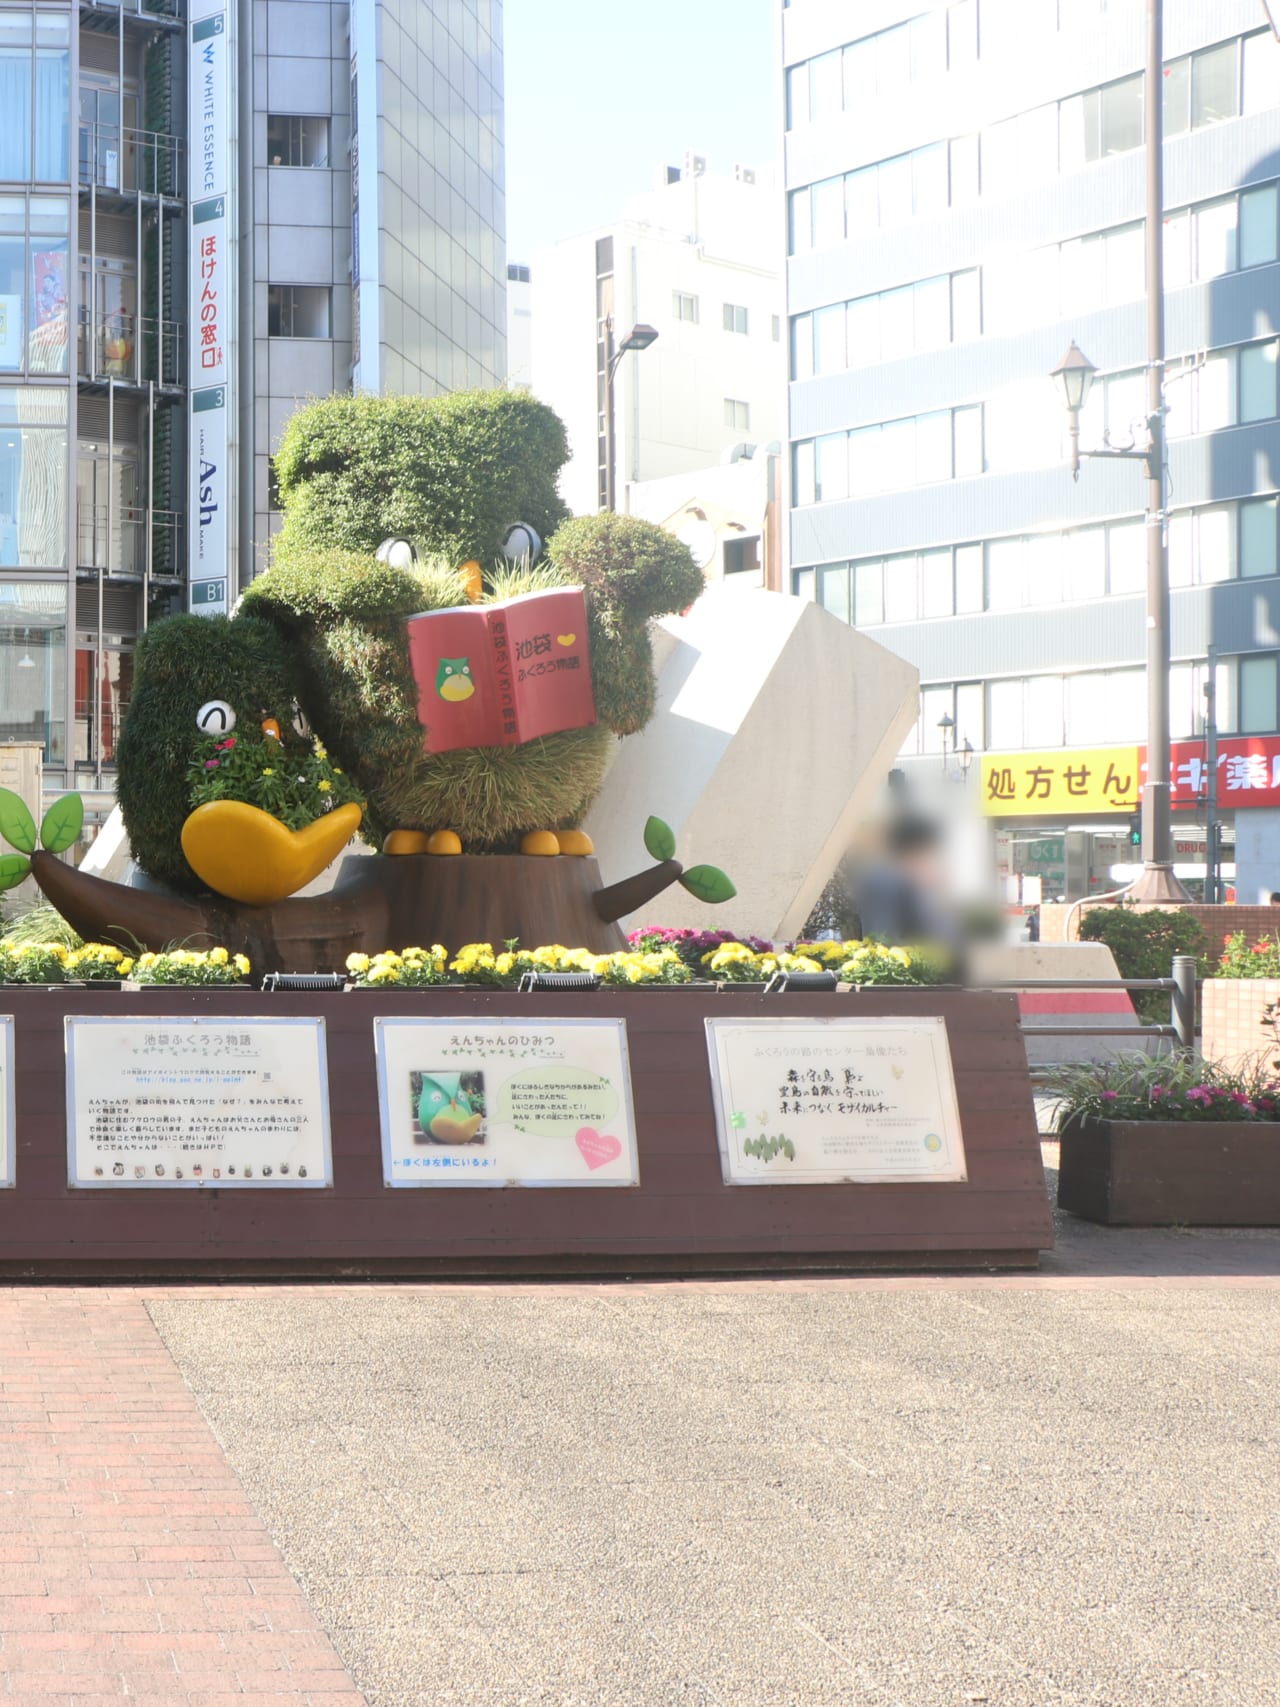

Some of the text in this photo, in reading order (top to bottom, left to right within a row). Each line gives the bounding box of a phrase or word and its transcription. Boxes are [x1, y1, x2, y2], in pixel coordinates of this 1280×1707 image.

[214, 17, 223, 33] 5
[204, 70, 214, 191] WHITE ESSENCE
[215, 201, 223, 216] 4
[201, 235, 217, 368] ほけんの窓口
[215, 391, 223, 406] 3
[200, 459, 218, 526] Ash
[208, 583, 223, 601] B1
[515, 633, 552, 661] 池袋
[518, 656, 580, 682] ふくろう物語
[988, 763, 1131, 799] 処方せん
[144, 1034, 251, 1046] 池袋ふくろう物語
[451, 1035, 554, 1046] えんちゃんのひみつ
